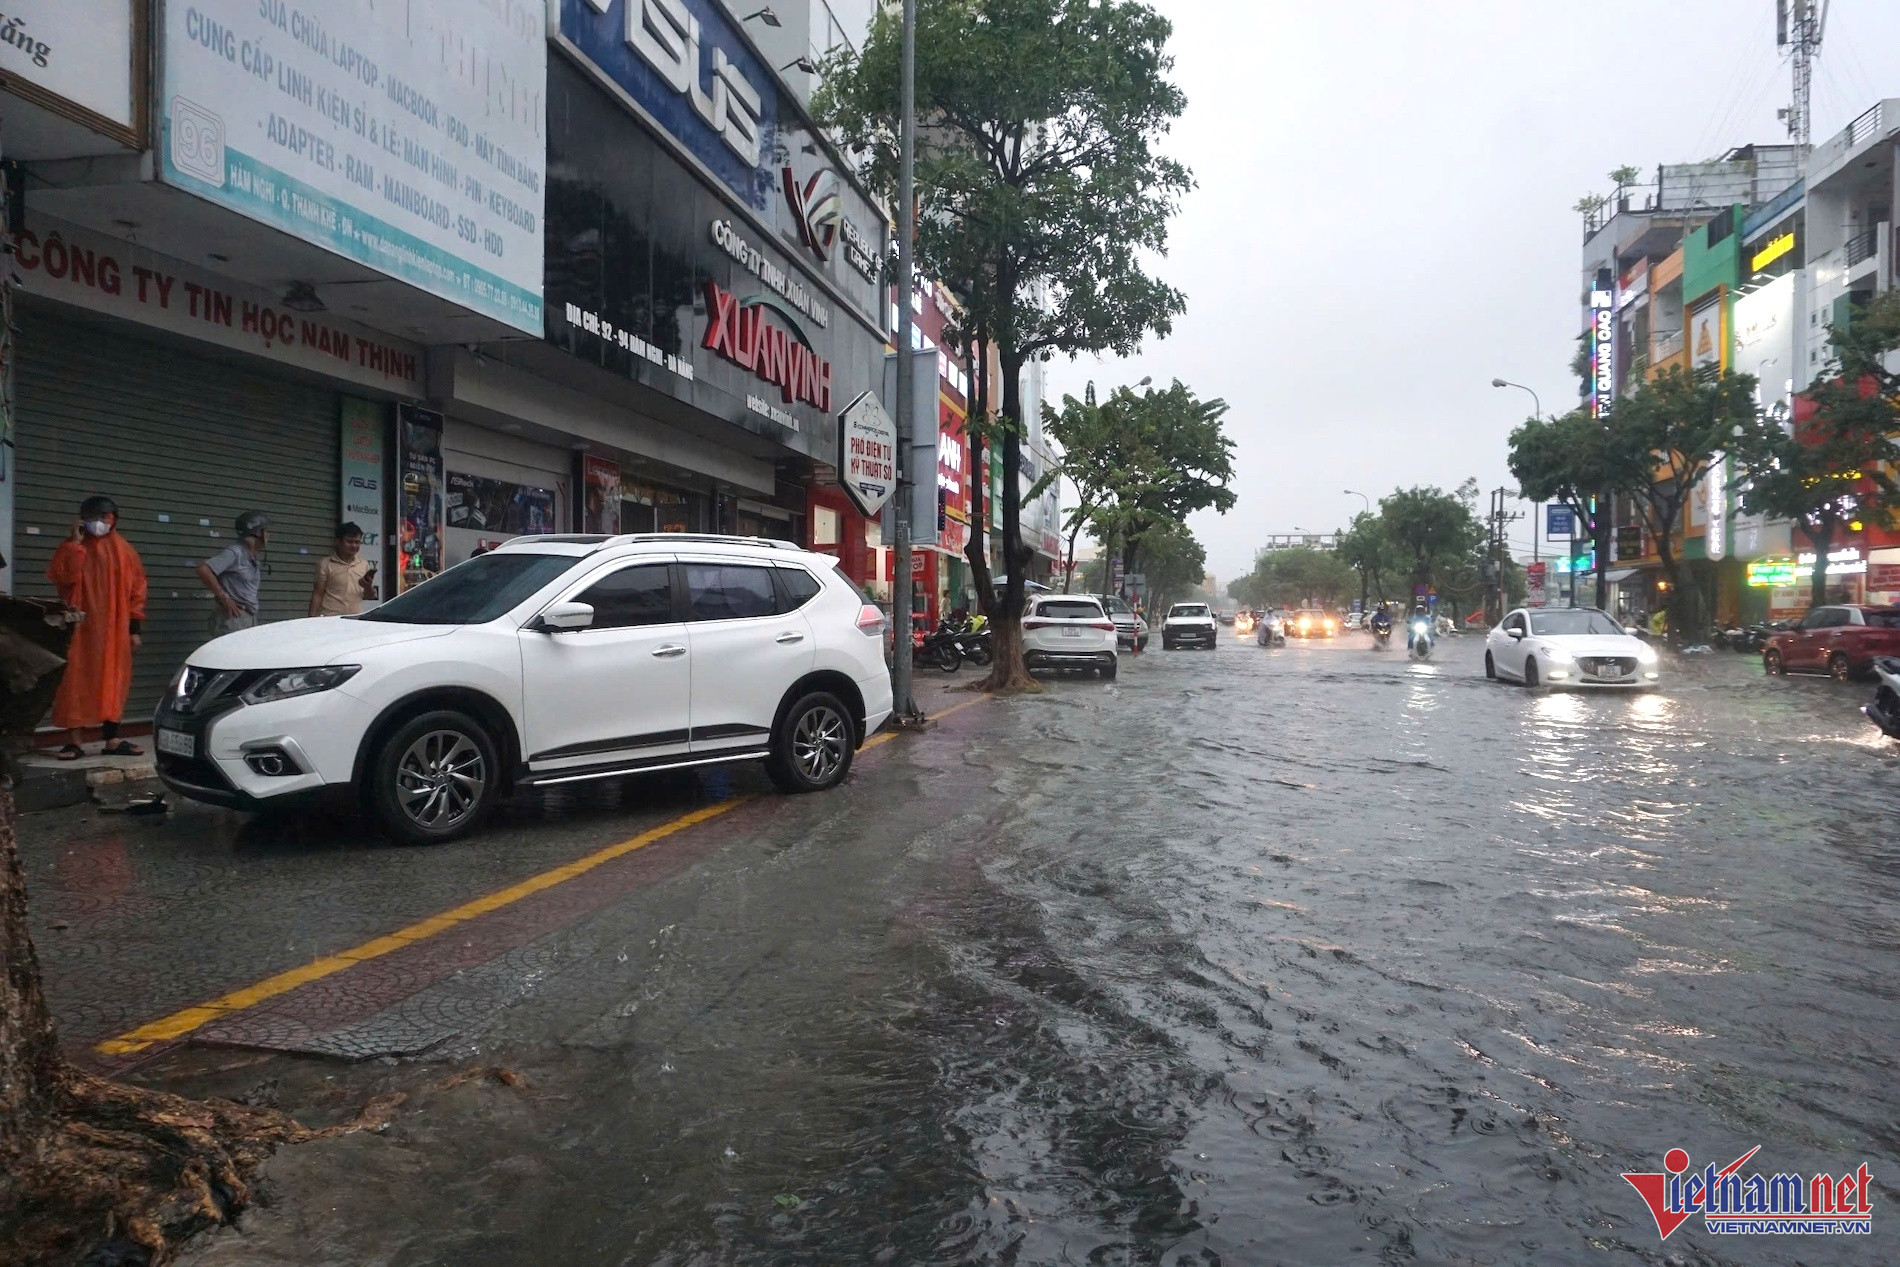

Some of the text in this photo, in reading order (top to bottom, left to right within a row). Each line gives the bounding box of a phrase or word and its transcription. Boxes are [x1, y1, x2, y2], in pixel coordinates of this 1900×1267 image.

[0, 12, 51, 68] ẵng
[186, 6, 235, 63] CUNG
[241, 36, 273, 82] CẤP
[278, 61, 312, 107] LINH
[317, 85, 351, 130] KIỆN
[369, 118, 379, 145] &
[404, 137, 429, 173] MÀN
[431, 152, 457, 190] HÌNH
[465, 175, 482, 204] PIN
[489, 189, 536, 234] KEYBOARD
[332, 37, 378, 88] LAPTOP
[387, 74, 438, 129] MACBOOK
[446, 114, 468, 147] IPAD
[475, 132, 494, 164] MÁY
[179, 118, 219, 168] 96
[267, 112, 334, 172] ADAPTER
[345, 156, 373, 192] RAM
[384, 174, 449, 230] MAINBOARD
[457, 214, 477, 243] SSD
[484, 228, 503, 257] HDD
[13, 228, 416, 382] CÔNG TY TIN HỌC NAM THỊNH
[711, 219, 828, 329] CÔNG TY TNHH XUÂN VINH
[565, 302, 582, 328] ĐỊA
[601, 320, 612, 341] 92
[618, 328, 629, 350] 94
[701, 281, 831, 413] XUANVINH
[348, 476, 378, 491] ASUS
[851, 435, 865, 455] PHỐ
[866, 440, 882, 459] ĐIỆN
[861, 459, 882, 480] THUẬT
